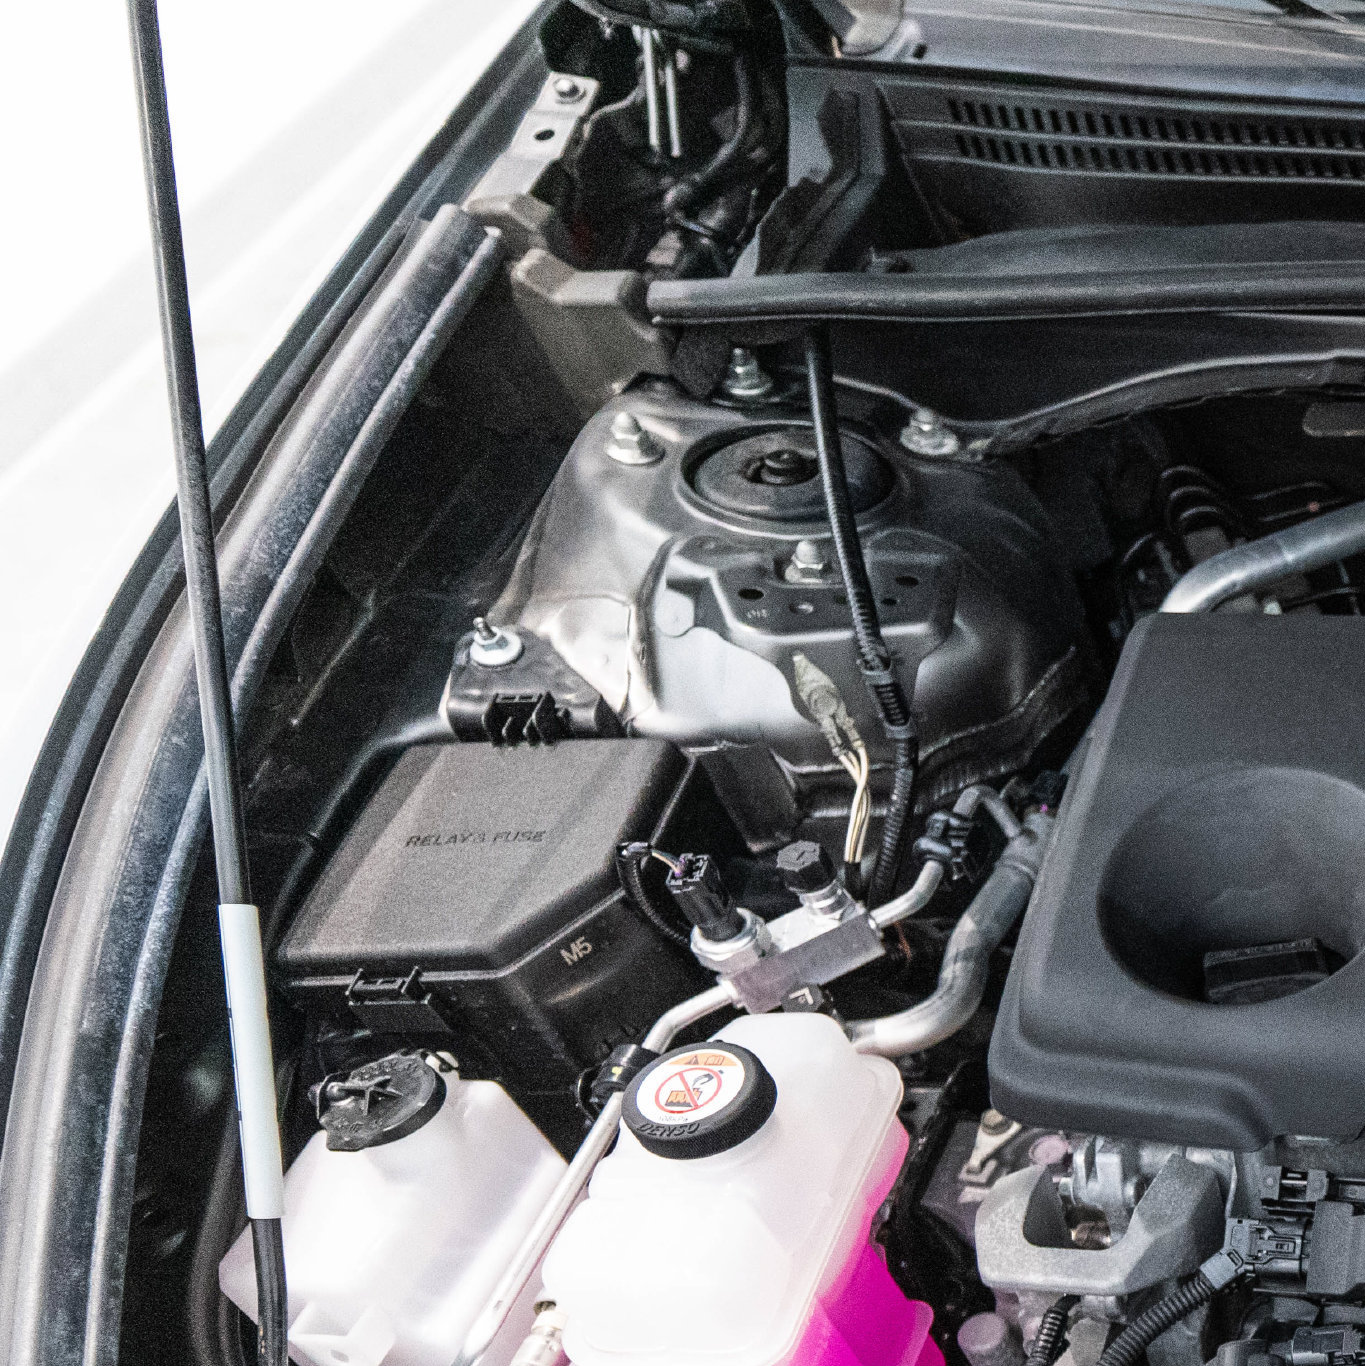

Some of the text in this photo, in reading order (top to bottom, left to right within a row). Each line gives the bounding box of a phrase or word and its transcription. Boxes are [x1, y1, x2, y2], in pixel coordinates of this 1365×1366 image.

[405, 832, 472, 848] RELAY
[493, 829, 547, 845] FUSE
[559, 936, 593, 966] M5
[636, 1122, 701, 1138] DENSO
